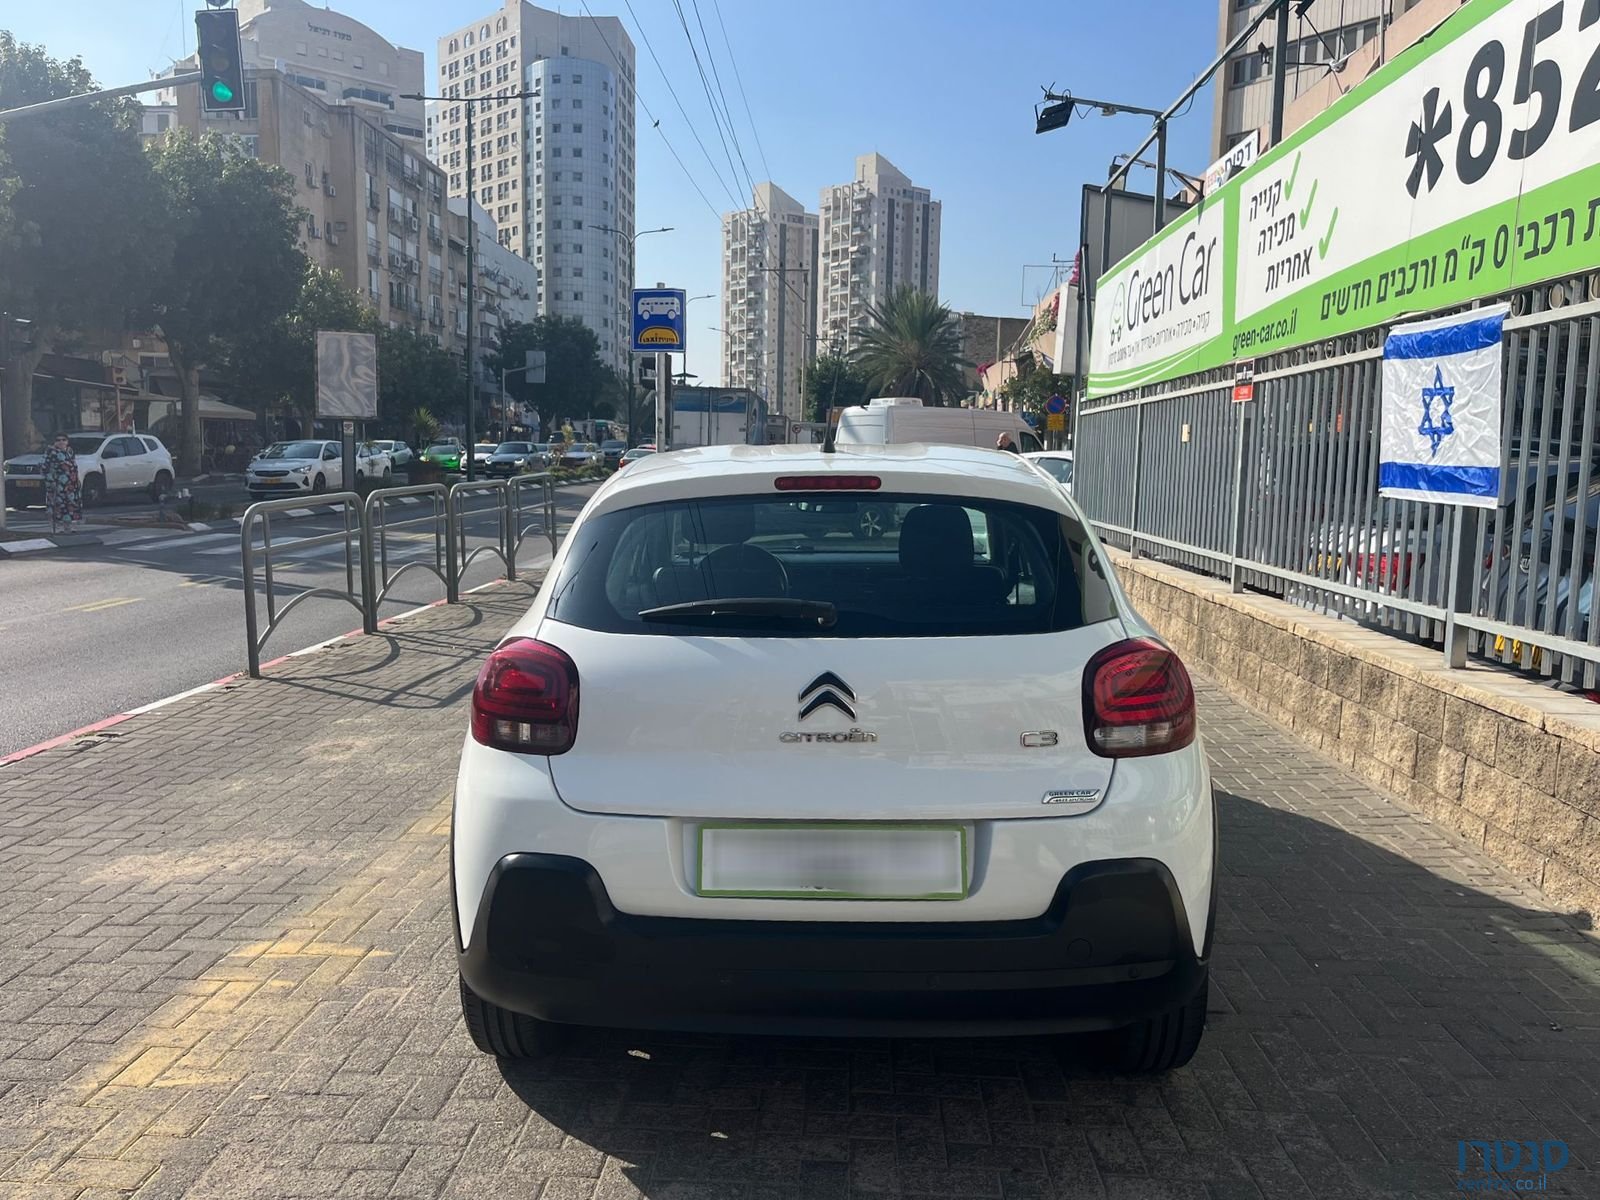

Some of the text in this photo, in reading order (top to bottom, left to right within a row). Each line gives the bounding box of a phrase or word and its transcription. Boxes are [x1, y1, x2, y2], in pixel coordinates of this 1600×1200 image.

[1249, 179, 1282, 222] קנייה
[1257, 212, 1296, 257] מכירה
[1493, 223, 1509, 269] 0
[1517, 207, 1575, 261] רכבי
[1127, 231, 1217, 331] Green Car
[1265, 245, 1313, 294] אחריות
[1376, 255, 1437, 304] ורכבים
[1320, 278, 1372, 321] חדשים
[1232, 307, 1298, 357] green-car.co.il
[1020, 730, 1059, 748] C3
